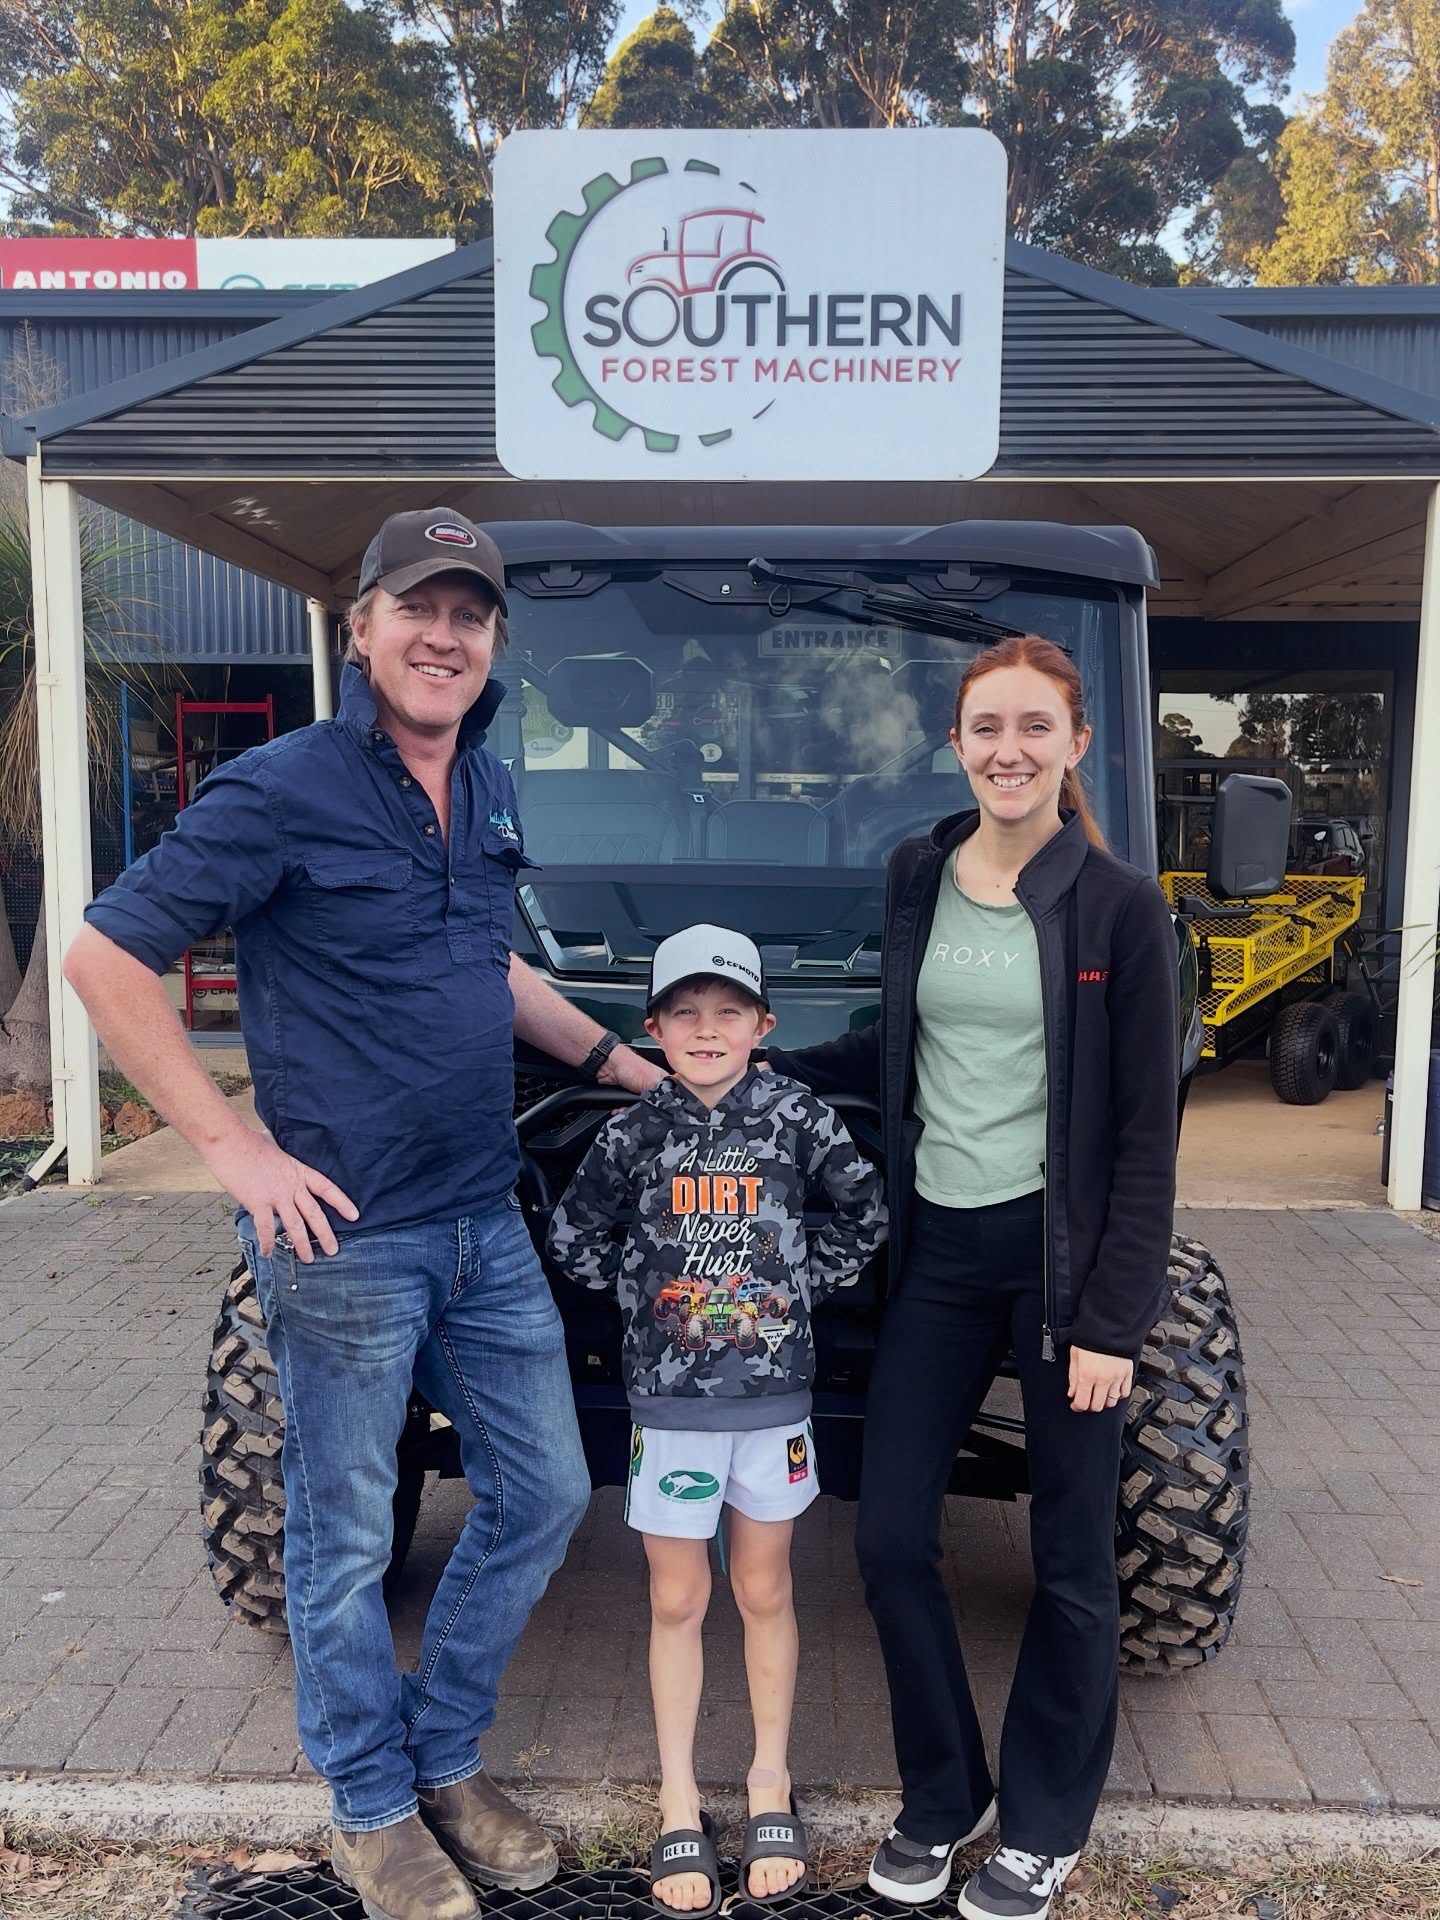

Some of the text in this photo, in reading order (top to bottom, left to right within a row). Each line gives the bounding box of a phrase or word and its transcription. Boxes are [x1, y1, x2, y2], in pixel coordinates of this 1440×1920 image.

[13, 270, 188, 290] ANTONIO
[583, 287, 962, 347] SOUTHERN
[601, 357, 963, 383] FOREST MACHINERY
[771, 630, 889, 649] ENTRANCE
[932, 943, 1020, 969] ROXY
[679, 1146, 758, 1173] A Little
[672, 1175, 763, 1215] DIRT
[677, 1213, 757, 1244] Never
[682, 1243, 752, 1275] Hurt
[759, 1828, 791, 1839] REEF
[664, 1843, 697, 1858] REEF
